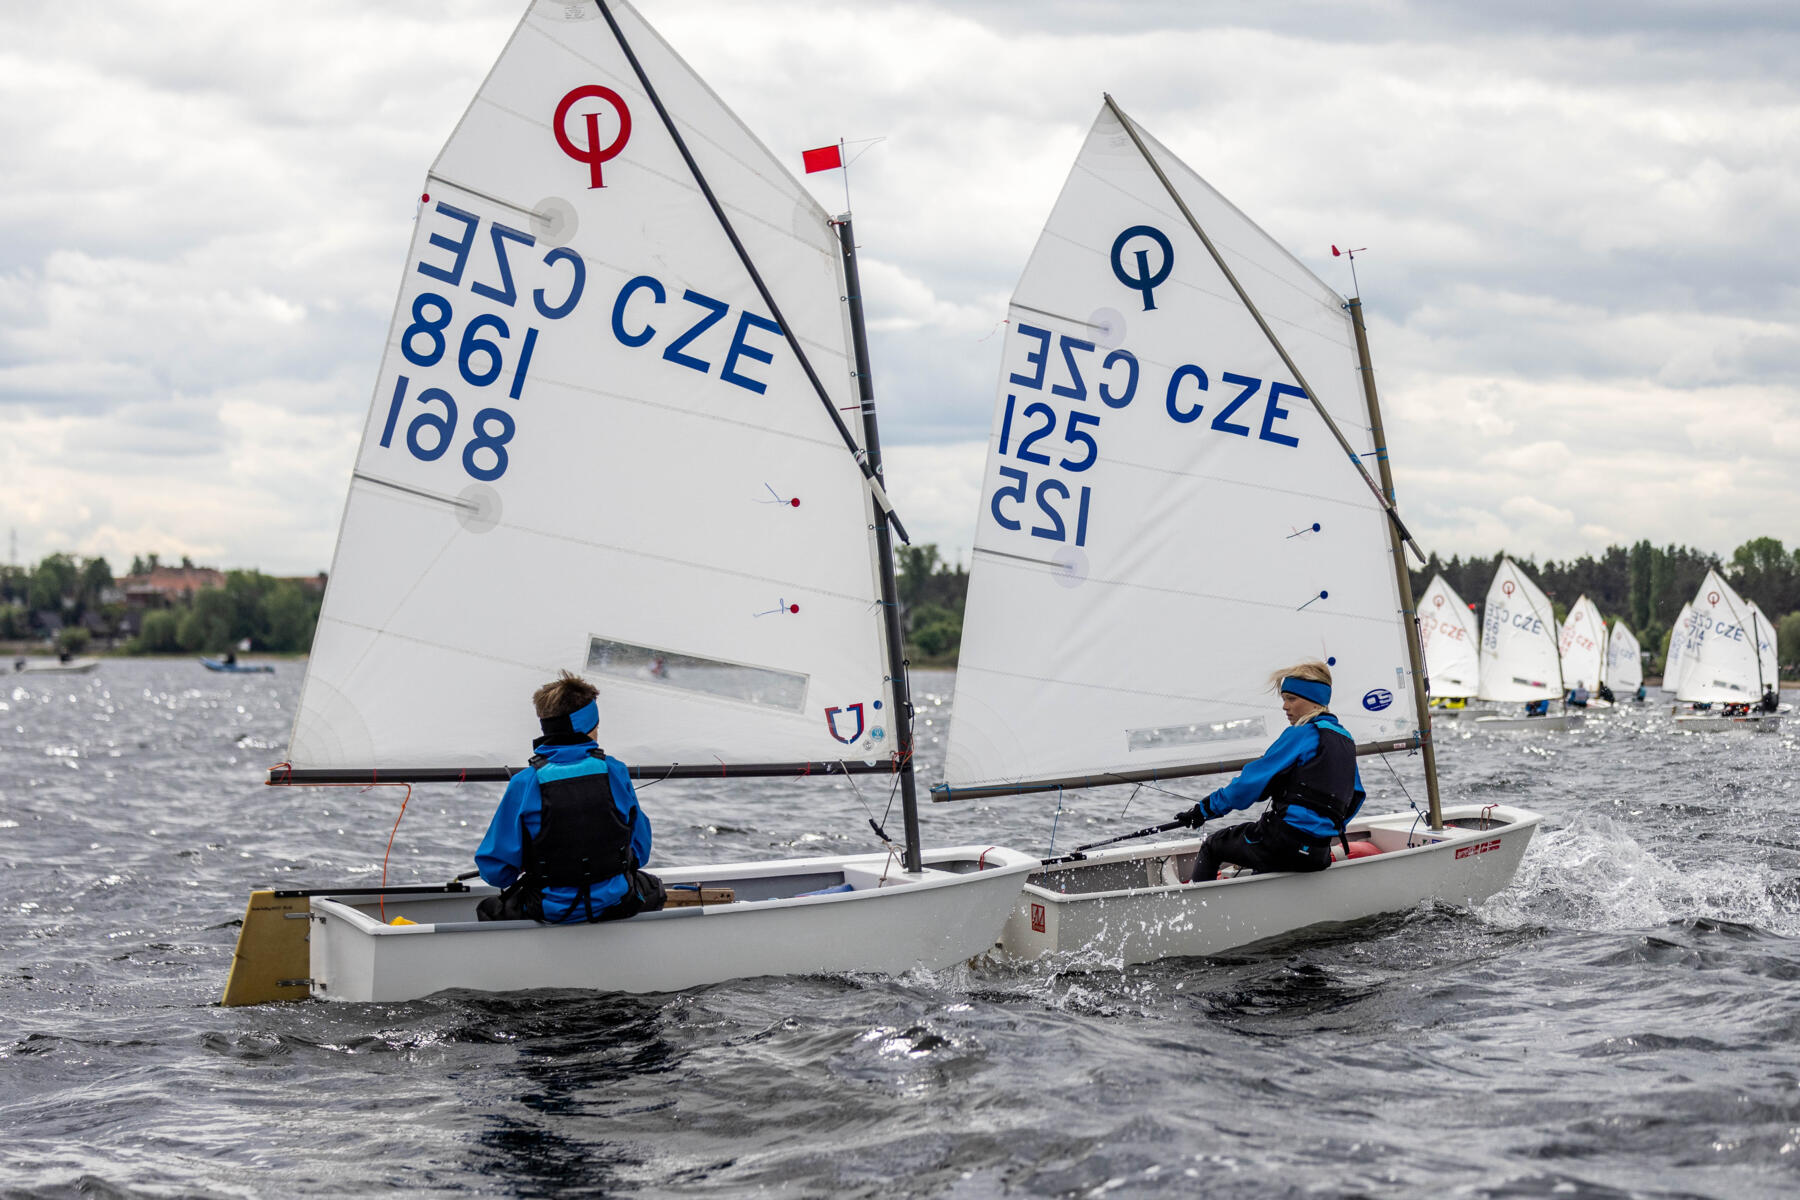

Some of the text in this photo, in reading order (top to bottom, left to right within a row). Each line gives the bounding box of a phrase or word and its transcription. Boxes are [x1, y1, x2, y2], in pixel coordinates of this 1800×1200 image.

[401, 293, 538, 400] 861
[611, 275, 784, 396] CZE
[1166, 364, 1309, 448] CZE
[998, 394, 1101, 473] 125
[1440, 622, 1466, 641] CZE
[1512, 614, 1543, 635] CZE
[1688, 624, 1706, 641] 714
[1715, 622, 1745, 642] CZE
